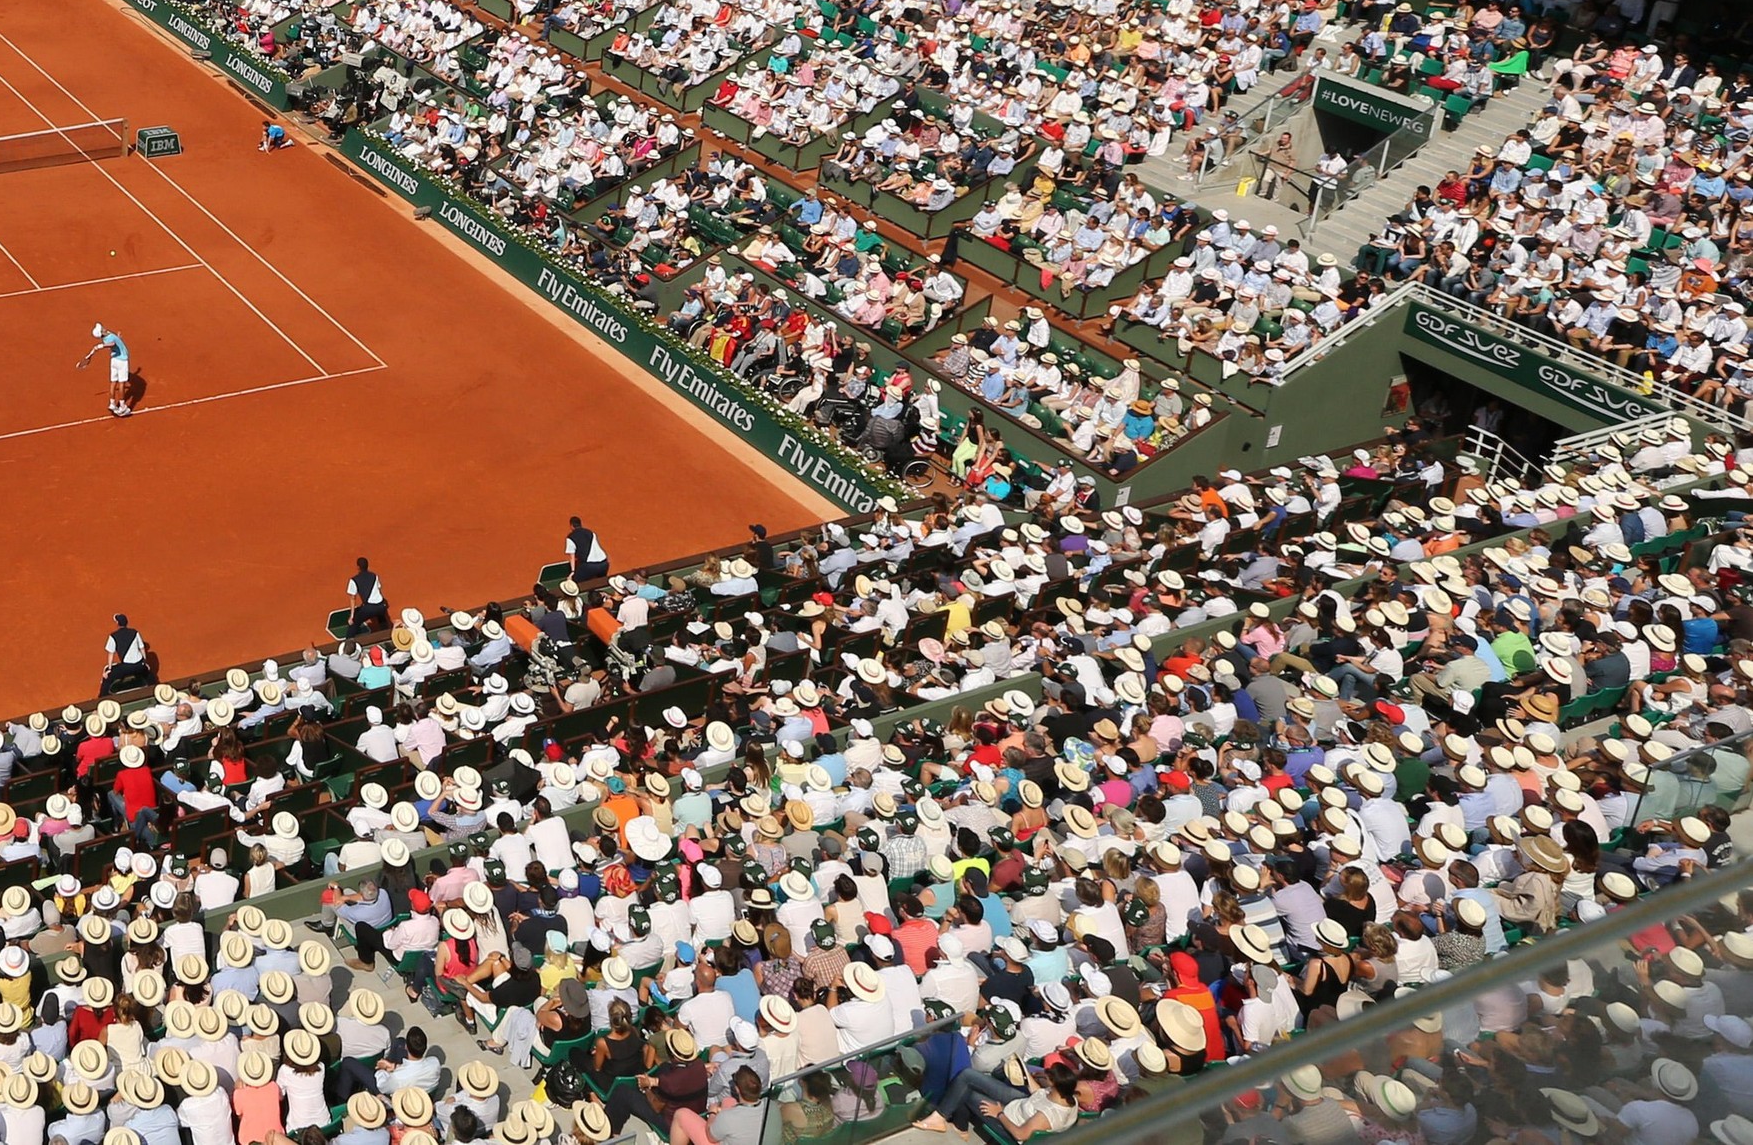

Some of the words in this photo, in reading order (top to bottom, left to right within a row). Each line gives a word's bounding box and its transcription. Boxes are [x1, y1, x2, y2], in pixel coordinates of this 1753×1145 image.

[167, 13, 212, 51] LONGINES
[225, 53, 274, 95] LONGINES
[150, 138, 176, 152] IBM
[1321, 89, 1424, 134] #LOVENEWRG
[358, 145, 419, 196] LONGINES
[438, 201, 507, 257] LONGINES
[536, 267, 564, 301] Fly
[562, 284, 630, 343] Emirates
[649, 344, 681, 375] Fly
[676, 367, 756, 432] Emirates
[777, 433, 814, 476] Fly
[1415, 310, 1460, 337] GDF
[1538, 365, 1589, 392] GDF
